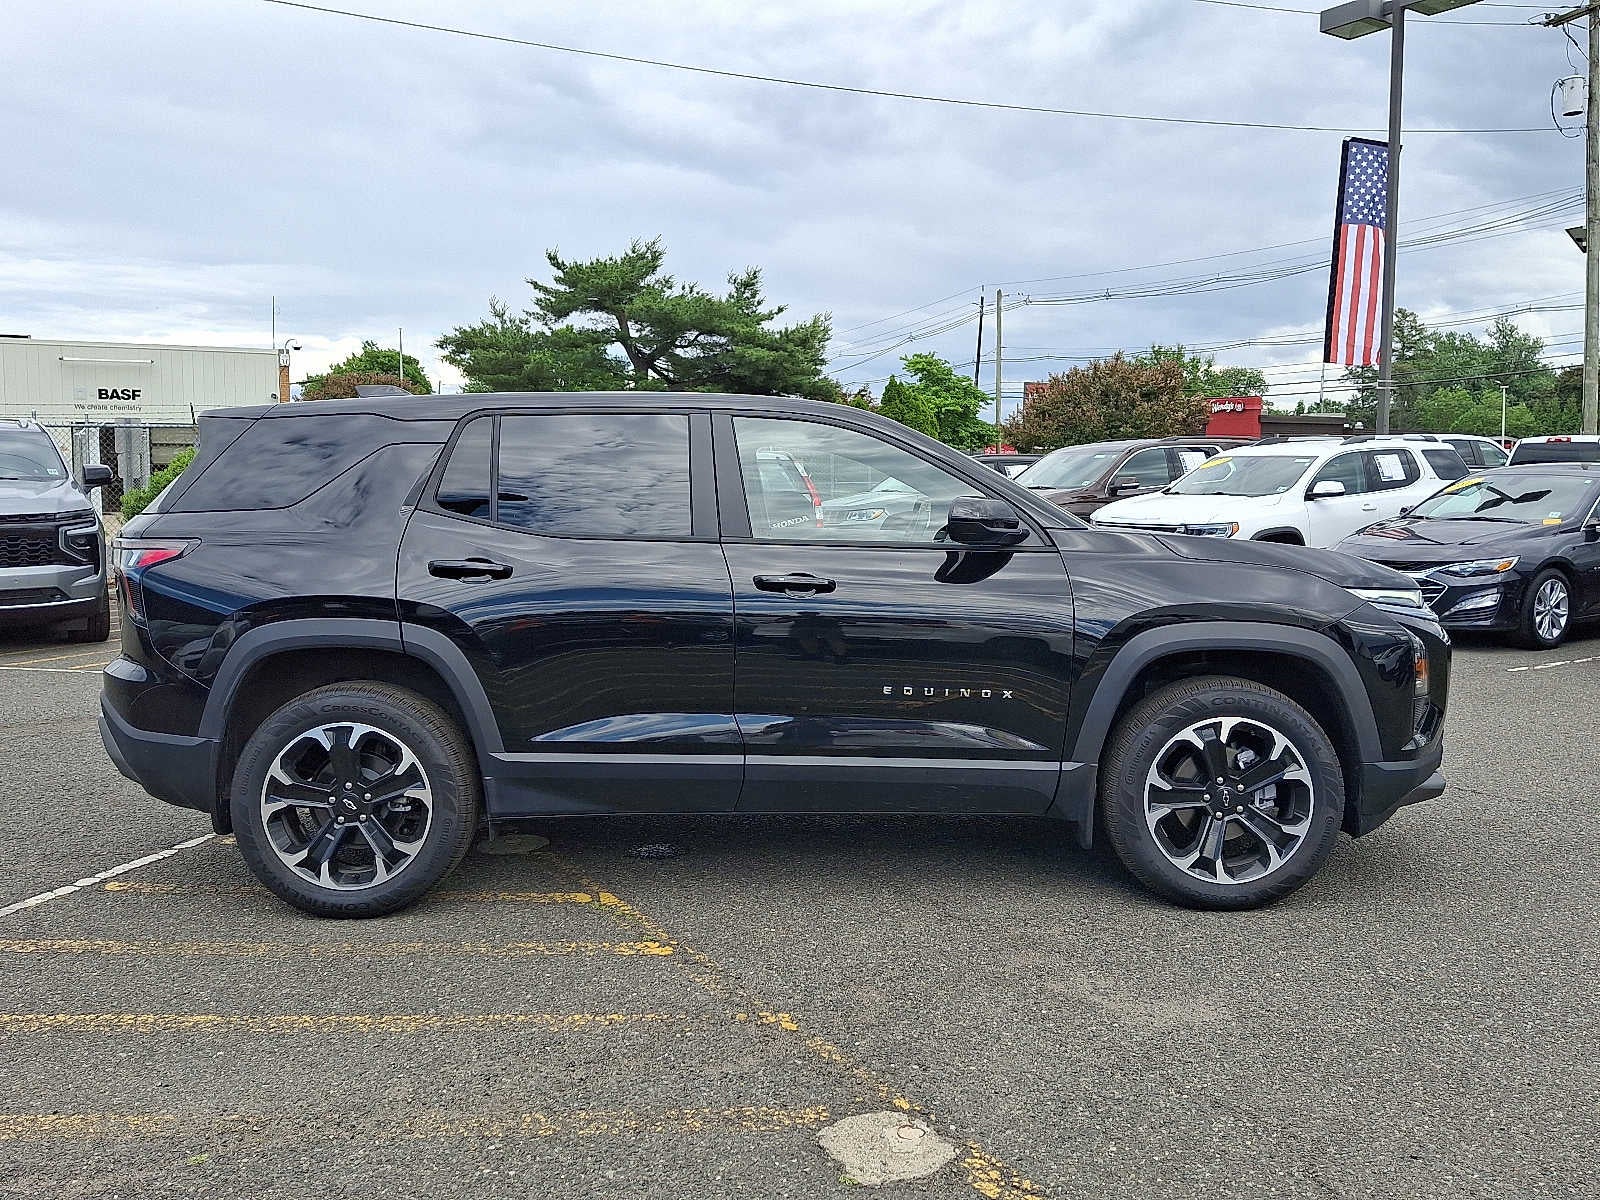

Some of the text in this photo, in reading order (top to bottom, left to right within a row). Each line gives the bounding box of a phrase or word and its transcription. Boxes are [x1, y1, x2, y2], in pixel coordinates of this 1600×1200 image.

[98, 388, 141, 400] BASF
[87, 403, 108, 411] create
[110, 404, 142, 412] chemistry
[1211, 401, 1234, 413] Wendy's
[883, 686, 1013, 699] EQUINOX
